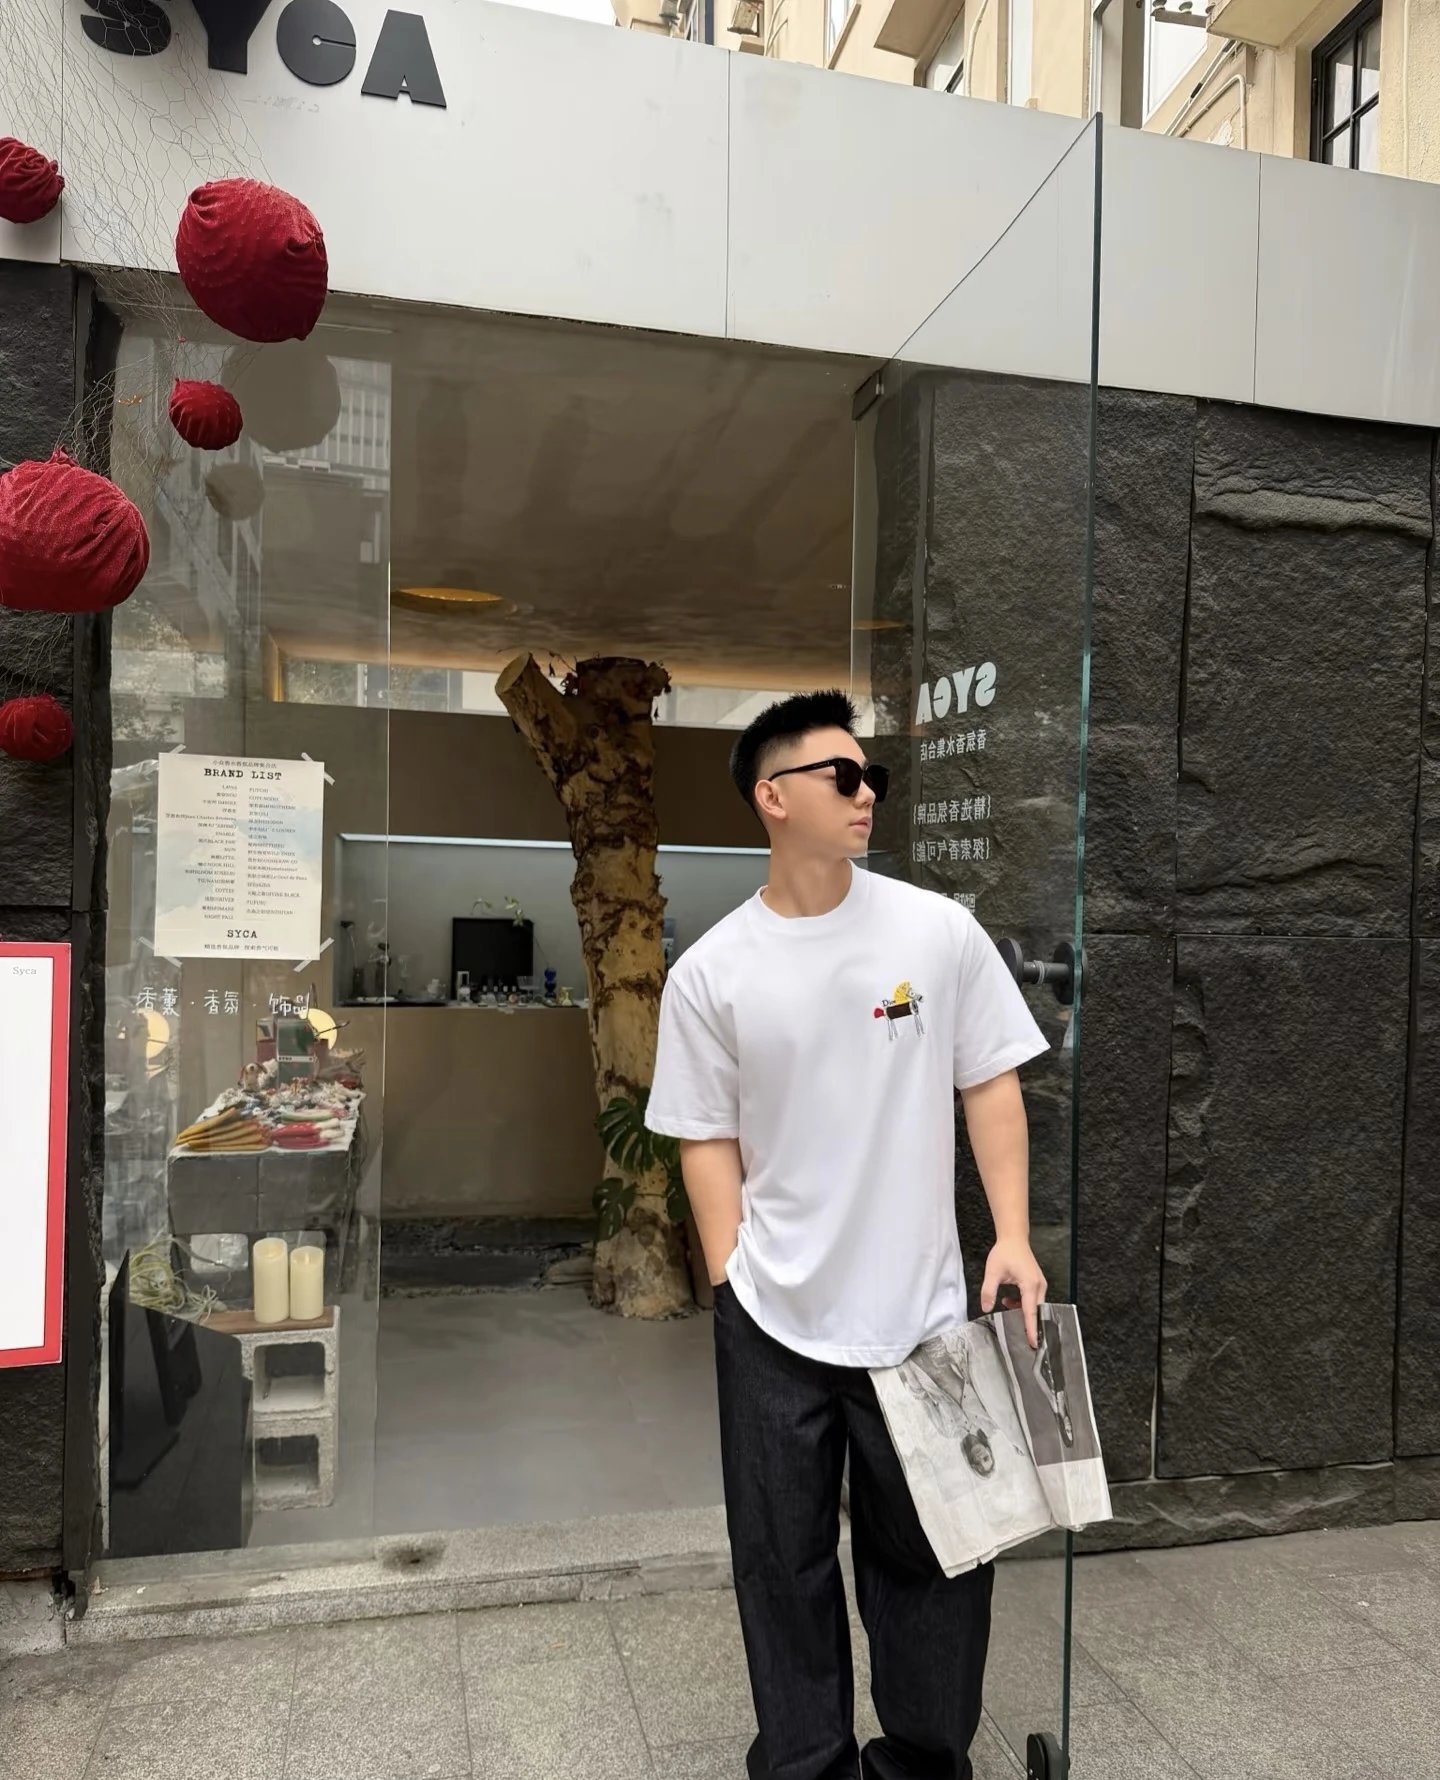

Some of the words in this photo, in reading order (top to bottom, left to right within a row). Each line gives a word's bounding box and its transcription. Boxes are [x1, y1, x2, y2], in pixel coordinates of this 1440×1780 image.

[80, 0, 447, 110] SYCA
[204, 768, 244, 778] BRAND
[251, 770, 282, 781] LIST
[227, 929, 258, 939] SYCA
[12, 966, 37, 976] Syca
[204, 989, 239, 1016] 香氛
